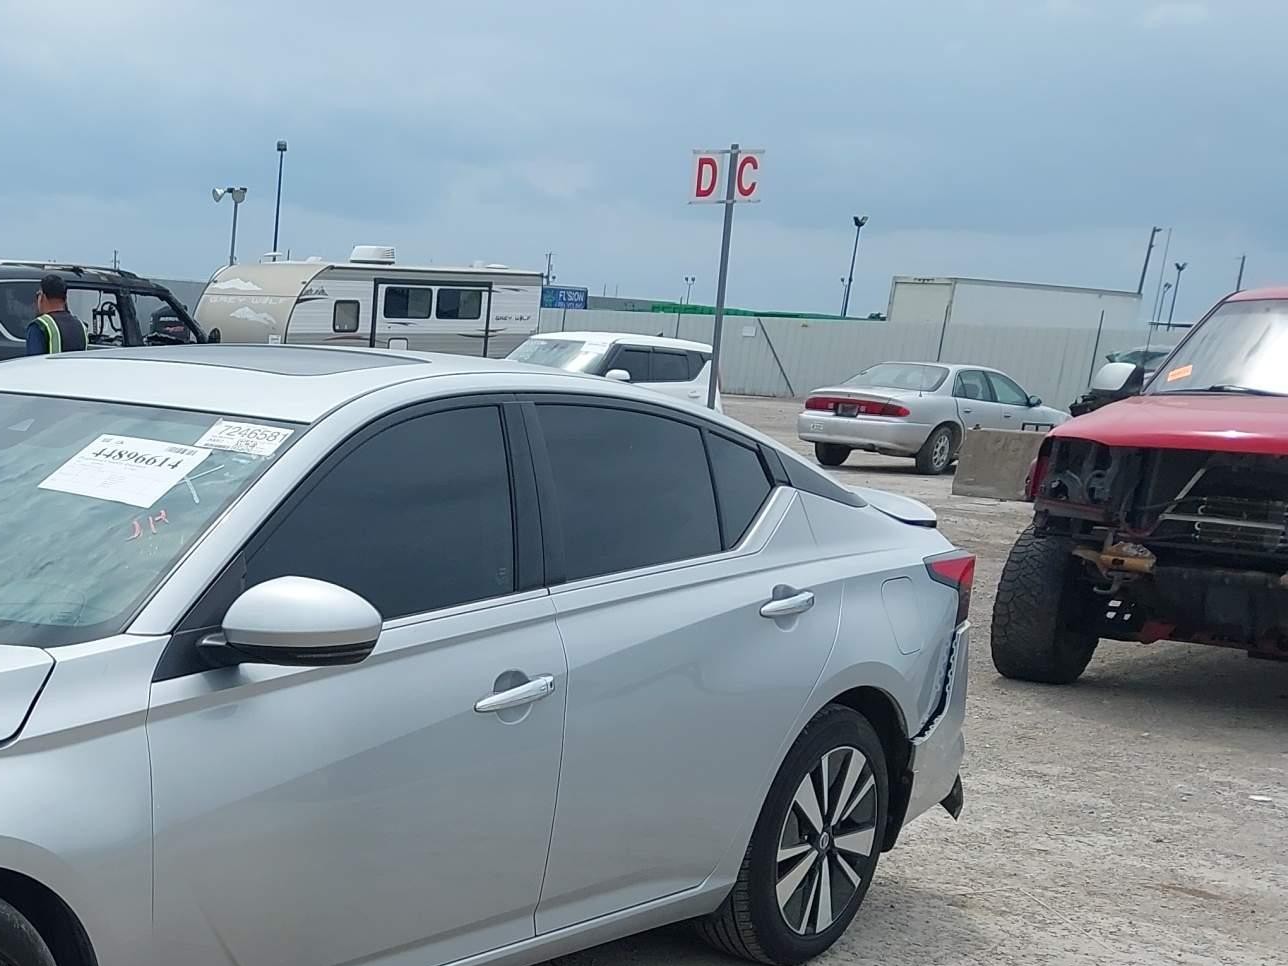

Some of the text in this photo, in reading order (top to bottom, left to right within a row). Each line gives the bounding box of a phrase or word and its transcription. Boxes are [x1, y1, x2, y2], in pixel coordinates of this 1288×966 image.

[695, 157, 718, 198] D
[736, 155, 758, 197] C
[218, 424, 289, 443] 7246581
[92, 447, 183, 470] 44896614
